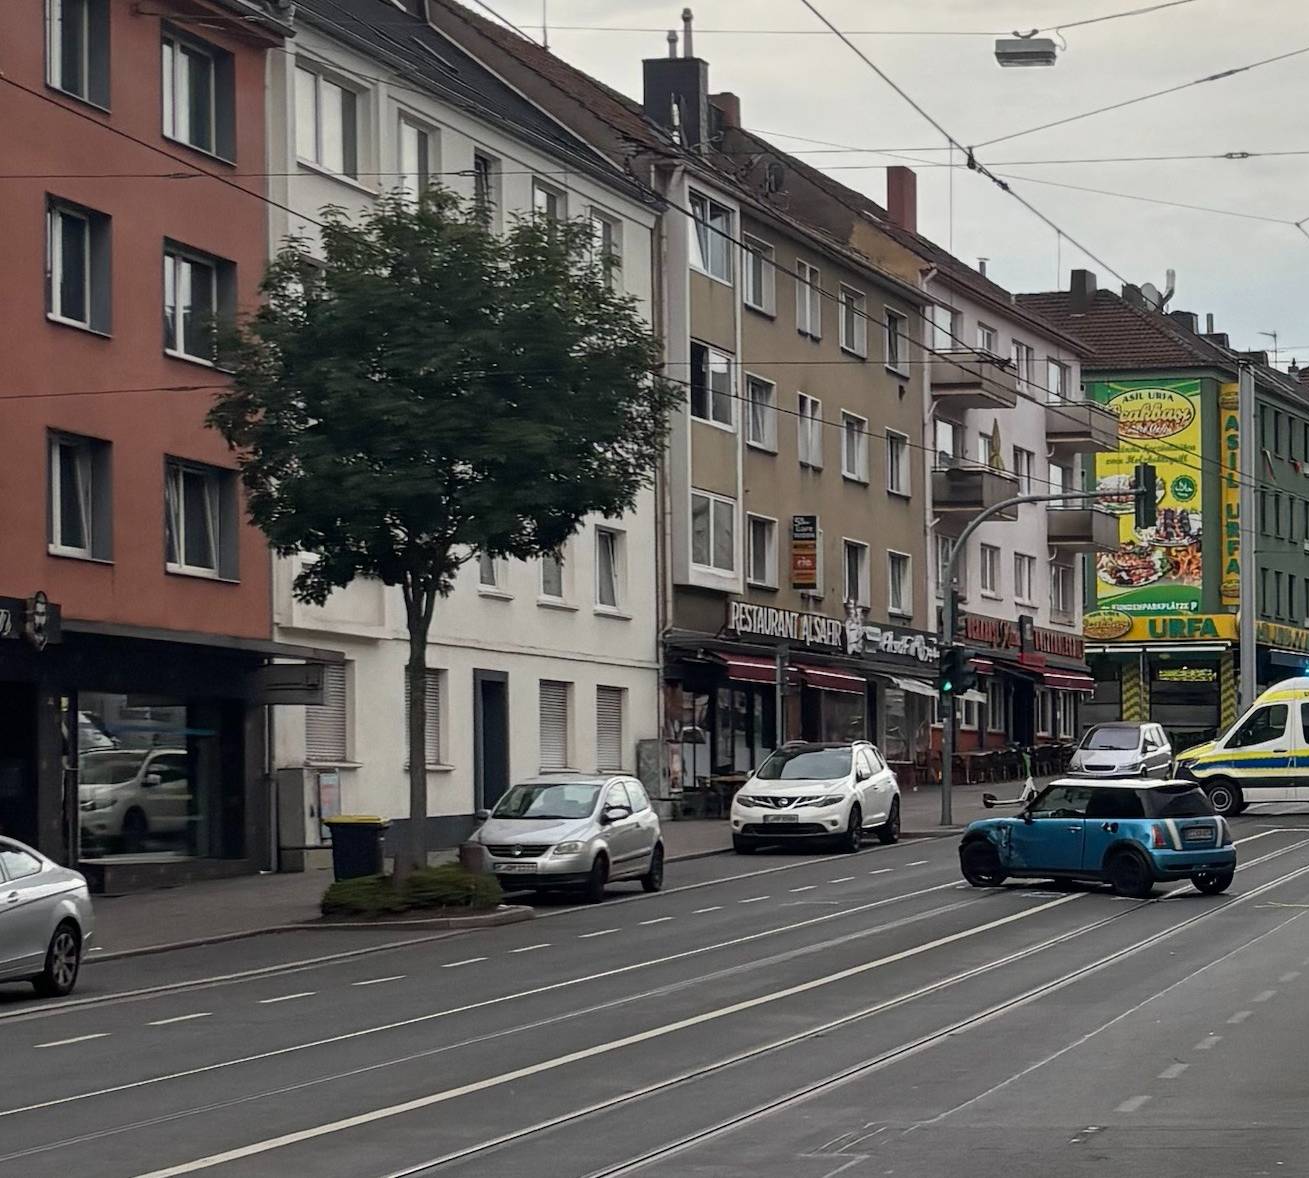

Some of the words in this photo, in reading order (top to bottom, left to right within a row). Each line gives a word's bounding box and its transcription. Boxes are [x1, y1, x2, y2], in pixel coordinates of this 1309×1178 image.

[1225, 415, 1240, 489] ASIL
[1226, 503, 1240, 575] URFA
[731, 602, 799, 639] RESTAURANT
[1149, 618, 1220, 638] URFA
